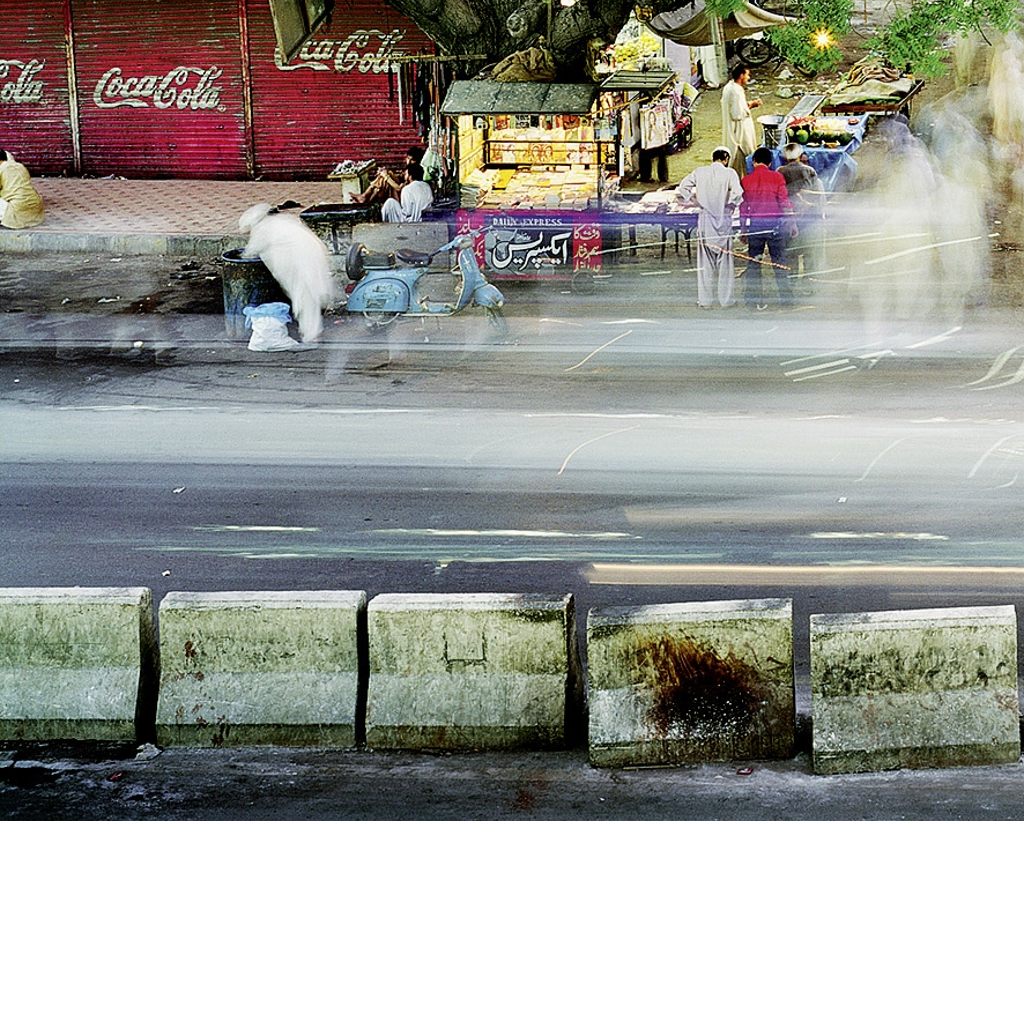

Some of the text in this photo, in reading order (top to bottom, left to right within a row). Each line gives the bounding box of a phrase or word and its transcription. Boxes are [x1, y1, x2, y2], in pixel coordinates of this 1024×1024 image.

[493, 217, 518, 227] DAILY
[521, 218, 563, 227] EXPRESS
[491, 231, 572, 271] ایکسپریس
